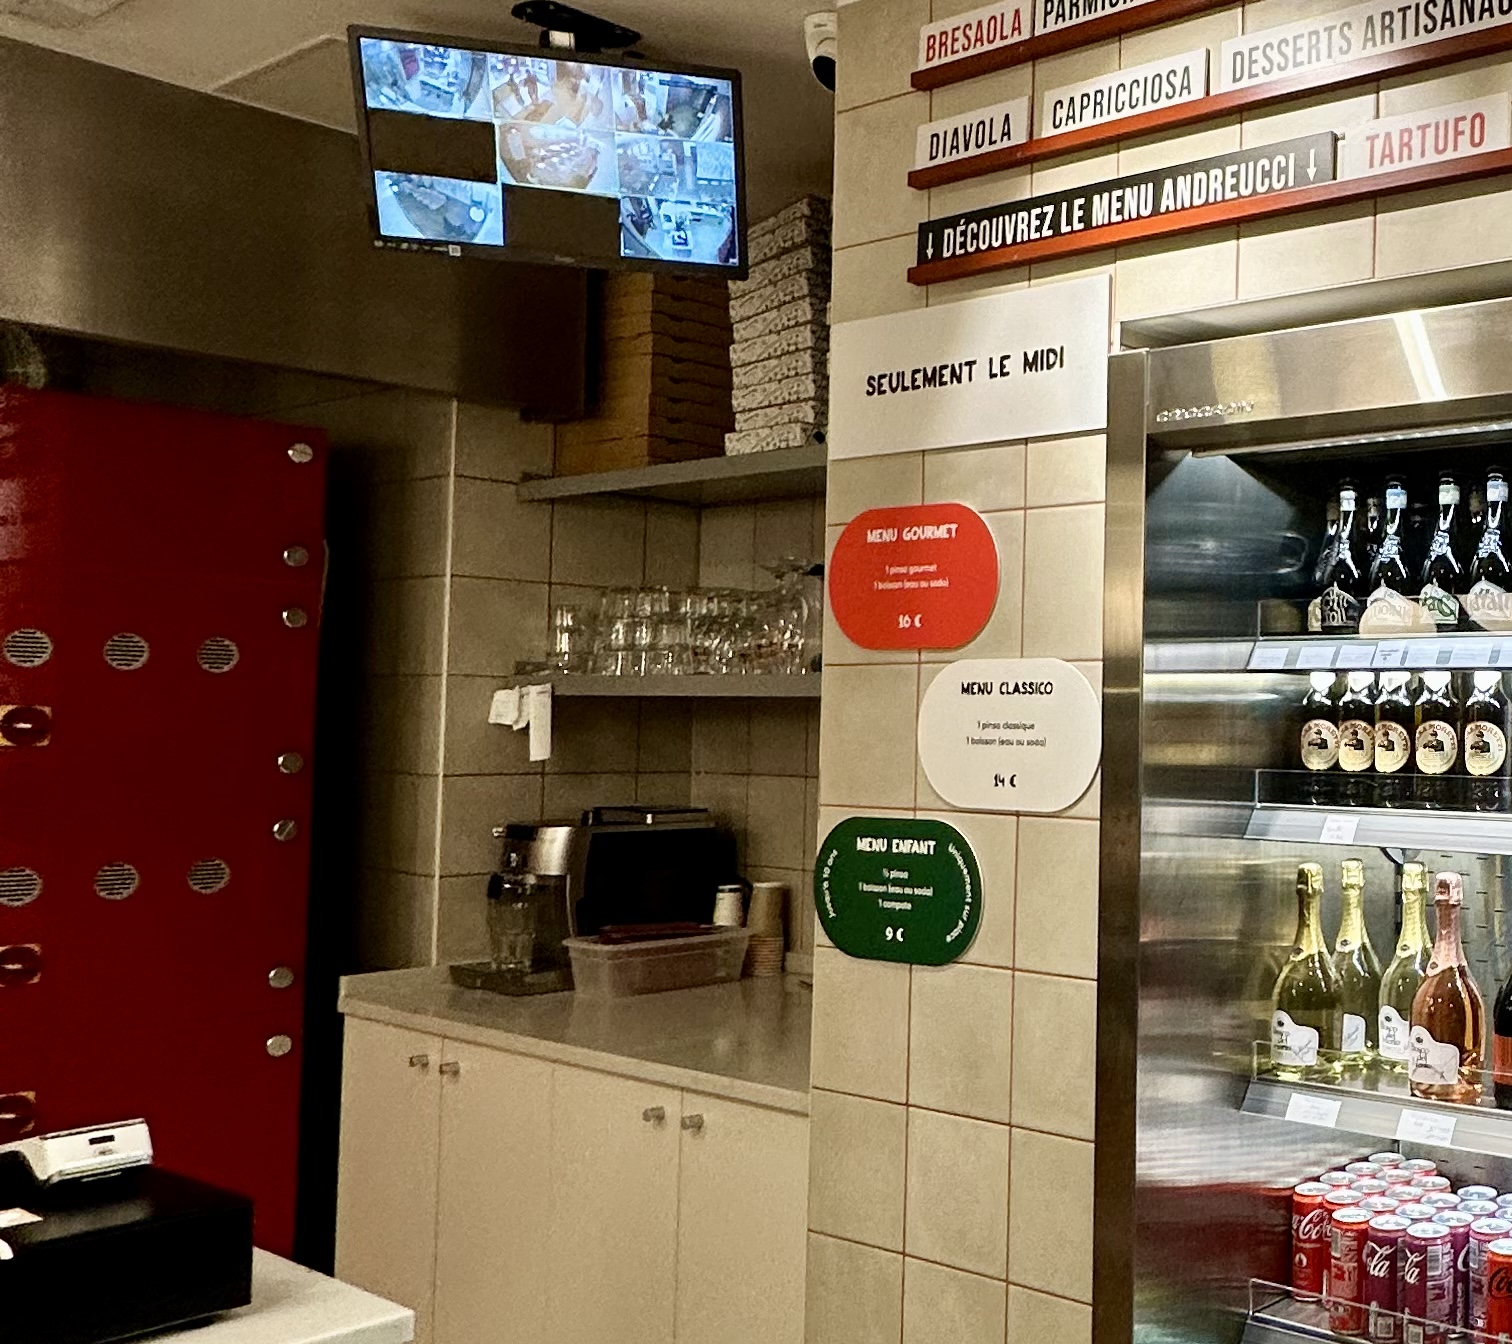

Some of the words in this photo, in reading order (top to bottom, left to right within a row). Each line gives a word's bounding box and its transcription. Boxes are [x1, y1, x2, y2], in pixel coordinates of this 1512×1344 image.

[925, 7, 1024, 63] BRESAOLA
[1232, 21, 1352, 84] DESSERTS
[1052, 65, 1192, 130] CAPRICCIOSA
[929, 113, 1013, 161] DIAVOLA
[1365, 112, 1487, 169] TARTUFO
[942, 205, 1054, 258] DÉCOUVREZ
[1061, 194, 1086, 234] LE
[1091, 179, 1154, 225] MENU
[1160, 152, 1295, 213] ANDREUCCI
[865, 360, 977, 397] SEULEMENT
[988, 354, 1011, 380] LE
[1022, 345, 1066, 375] MIDI
[867, 529, 898, 543] MENU
[903, 523, 958, 541] GOURMET
[961, 681, 993, 695] MENU
[999, 681, 1053, 695] CLASSICO
[1002, 721, 1035, 732] classique
[994, 774, 1005, 787] 14
[1010, 774, 1017, 787] €
[856, 837, 887, 852] MENU
[892, 839, 936, 855] ENFANT
[885, 927, 894, 940] 9
